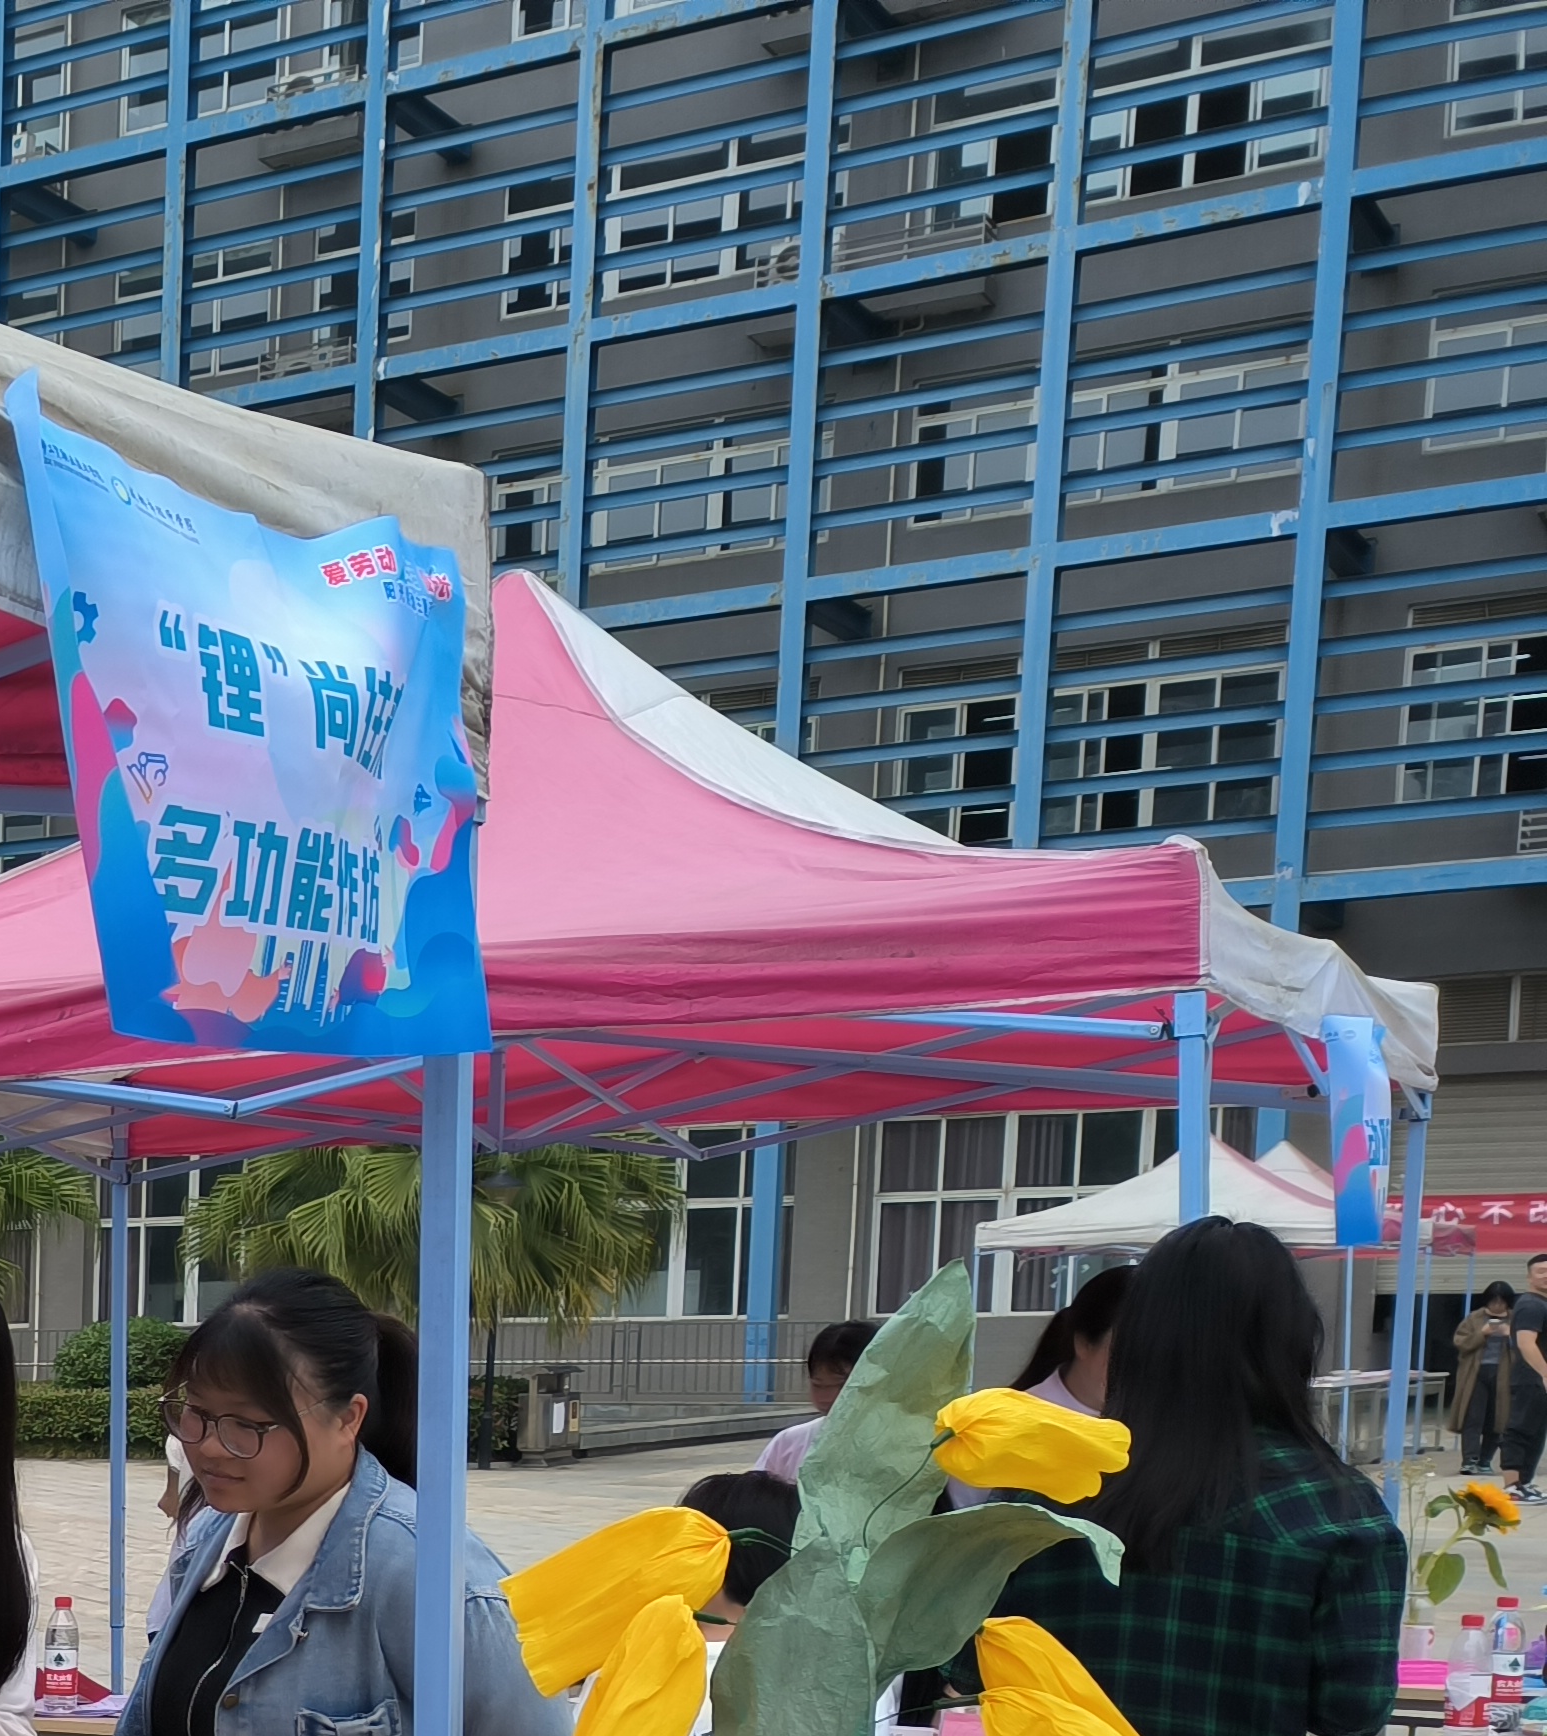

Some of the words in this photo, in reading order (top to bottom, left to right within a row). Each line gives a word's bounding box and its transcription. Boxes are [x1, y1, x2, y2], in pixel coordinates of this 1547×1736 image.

[152, 803, 381, 945] 多功能作坊
